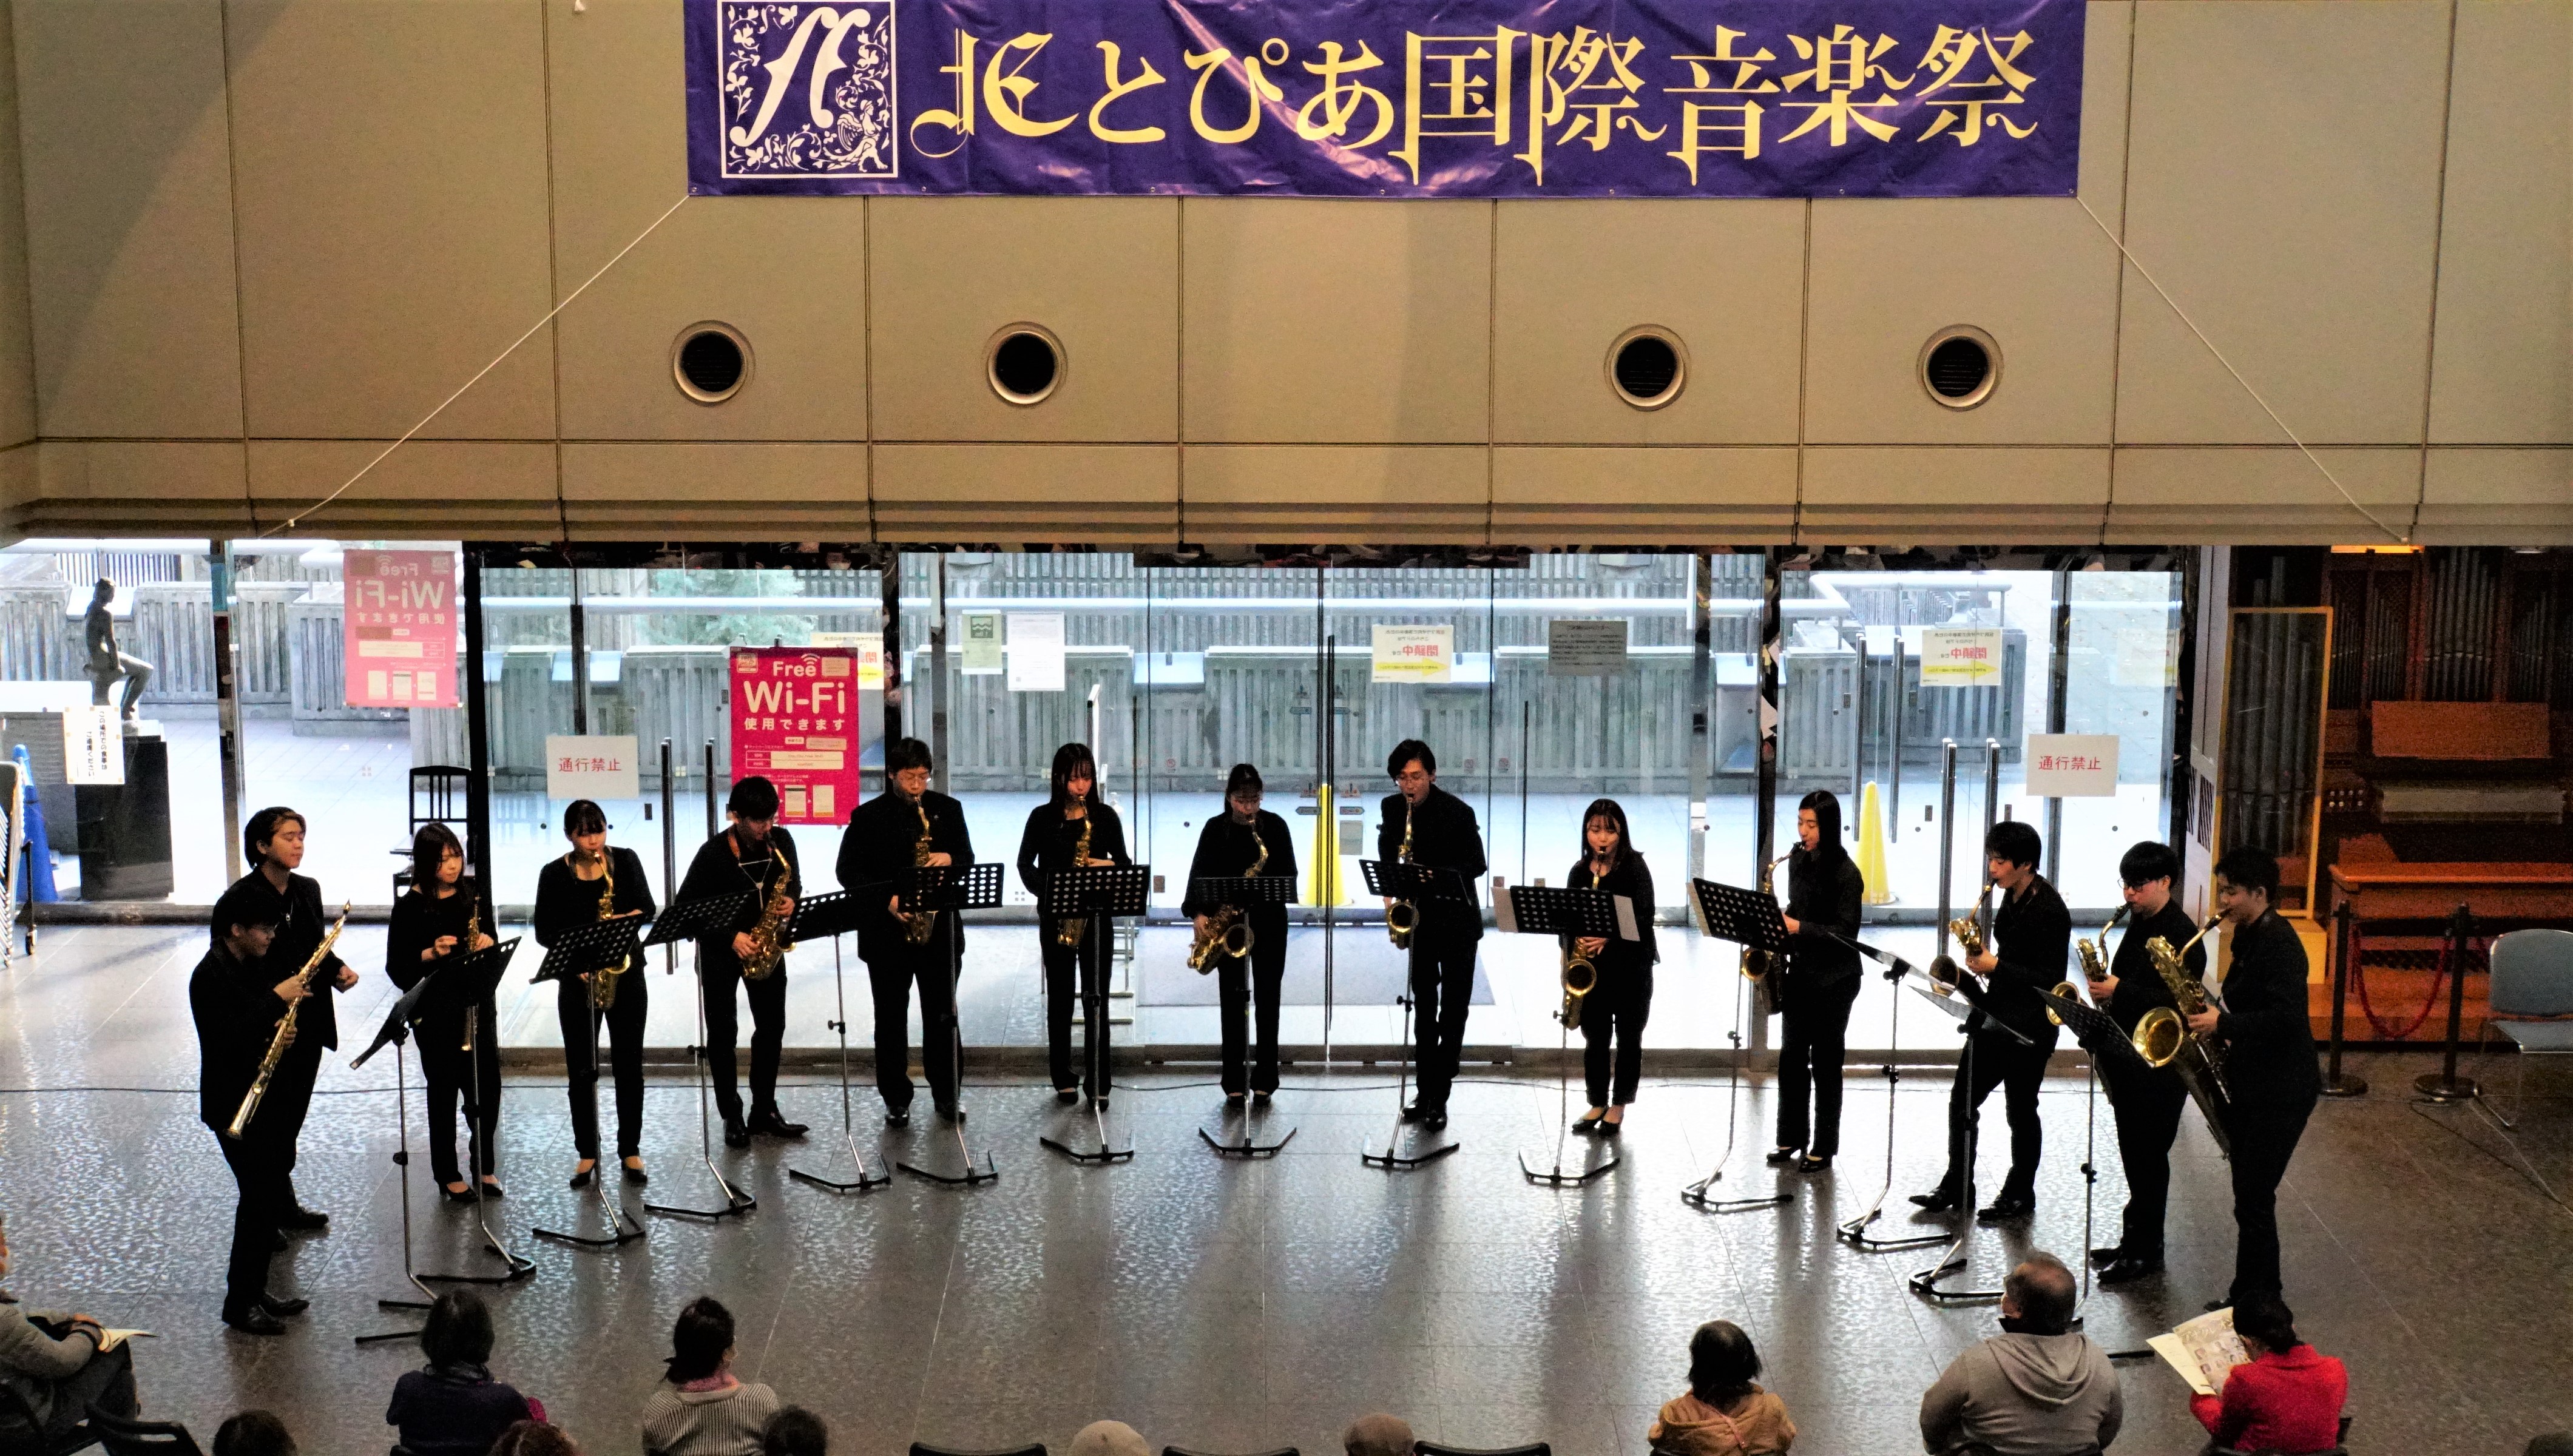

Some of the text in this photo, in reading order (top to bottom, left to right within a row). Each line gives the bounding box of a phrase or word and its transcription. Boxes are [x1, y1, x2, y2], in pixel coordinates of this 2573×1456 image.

[911, 24, 2037, 186] 北とぴあ国際音楽祭
[773, 661, 817, 677] Free
[743, 680, 845, 714] Wi-Fi
[744, 717, 845, 731] 使用できます
[558, 757, 622, 772] 通行禁止
[2038, 755, 2102, 771] 通行禁止
